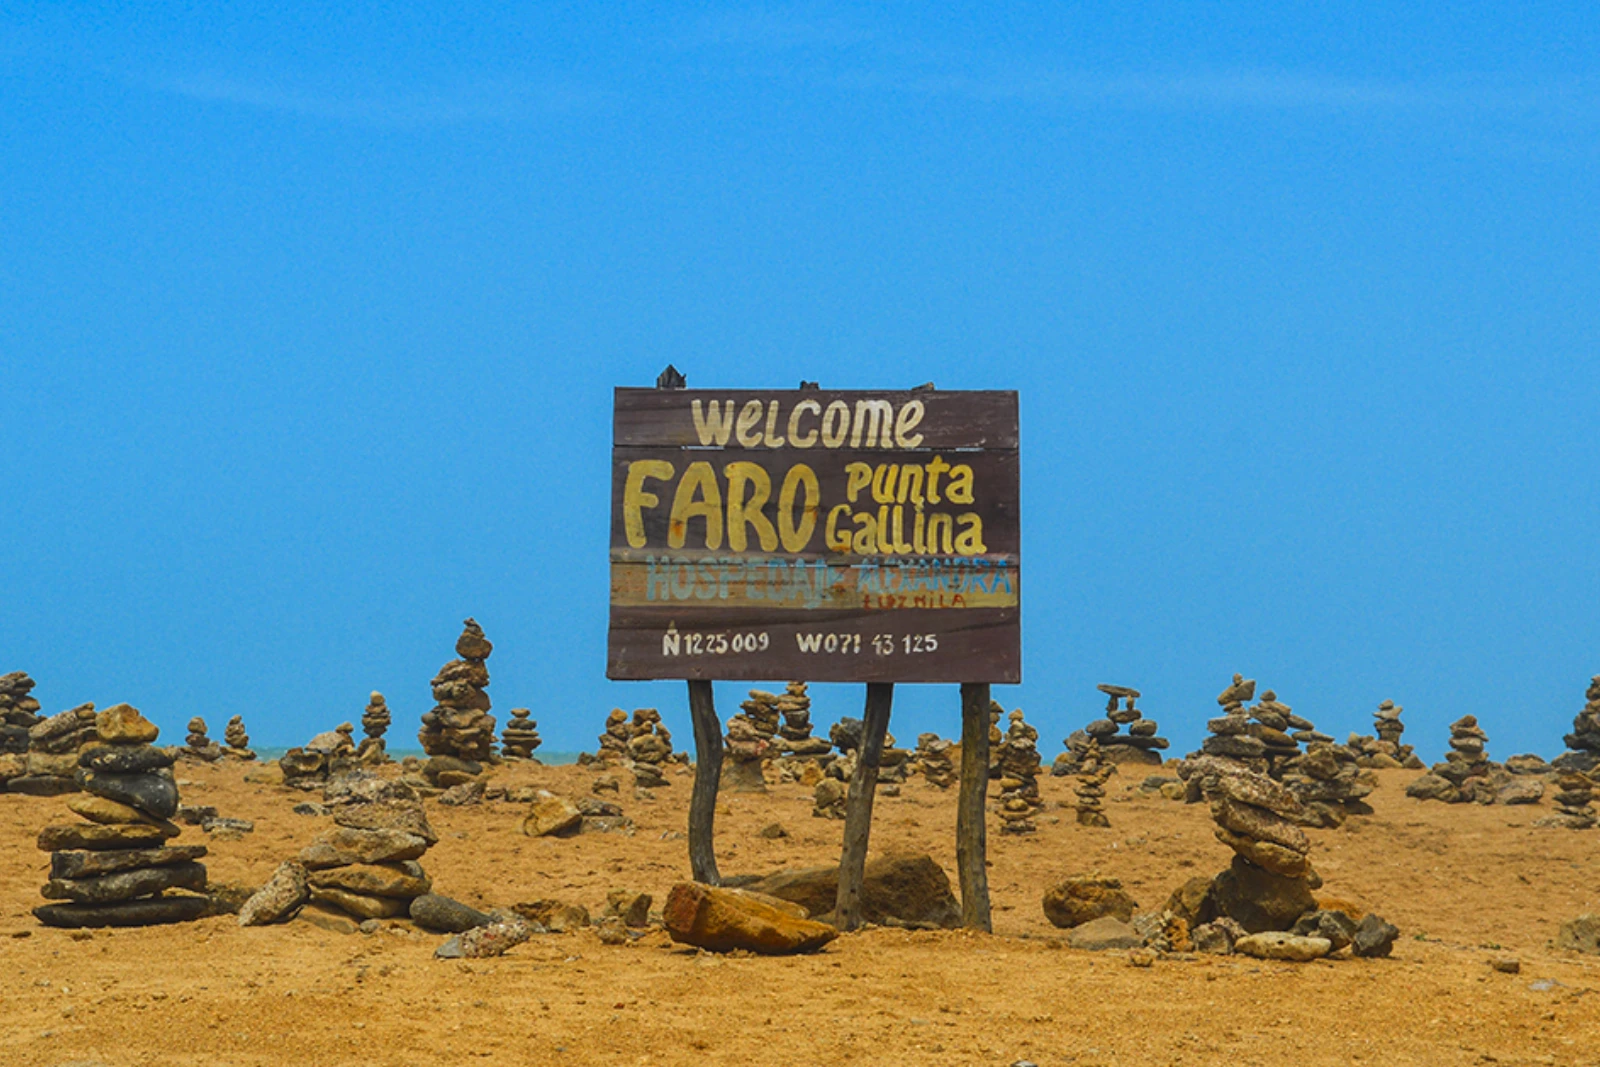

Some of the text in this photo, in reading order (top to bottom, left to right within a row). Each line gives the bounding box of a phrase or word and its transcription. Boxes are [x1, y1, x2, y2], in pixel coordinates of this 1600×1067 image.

[623, 458, 820, 554] FARO
[825, 497, 987, 557] Gallina
[646, 555, 1012, 610] HOSPEDAJE ALEXANDRA
[902, 633, 938, 655] 125
